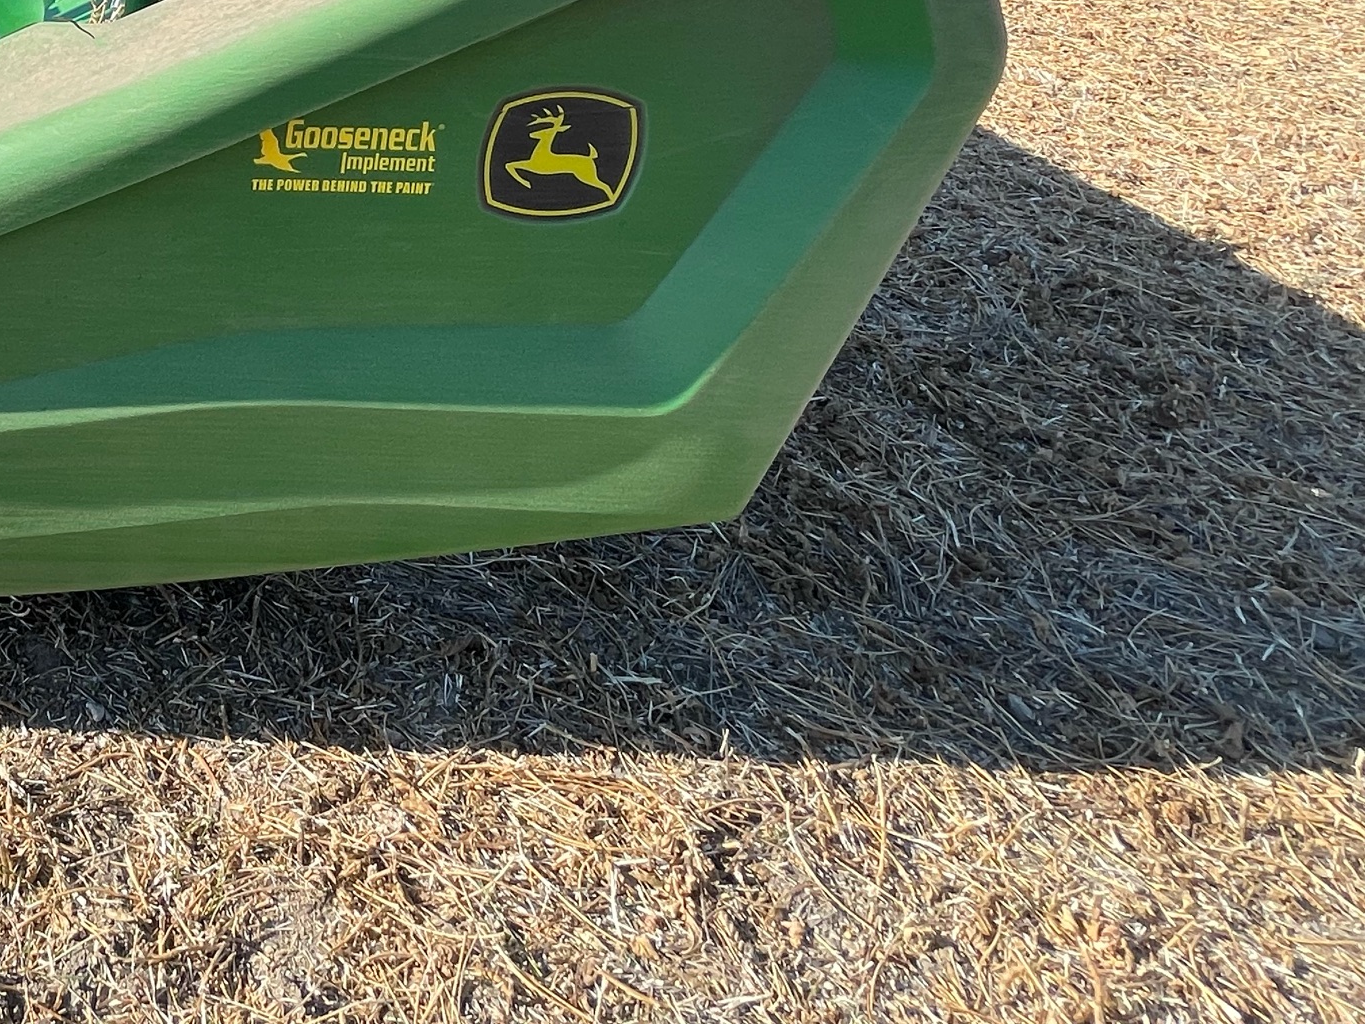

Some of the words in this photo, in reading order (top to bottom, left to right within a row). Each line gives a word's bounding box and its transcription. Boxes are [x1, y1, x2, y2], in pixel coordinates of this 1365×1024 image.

[285, 119, 436, 152] Gooseneck
[340, 152, 436, 174] Implement
[251, 179, 273, 191] THE
[276, 179, 319, 192] POWER
[321, 179, 367, 193] BEHIND
[371, 180, 393, 194] THE
[395, 181, 432, 195] PAINT
